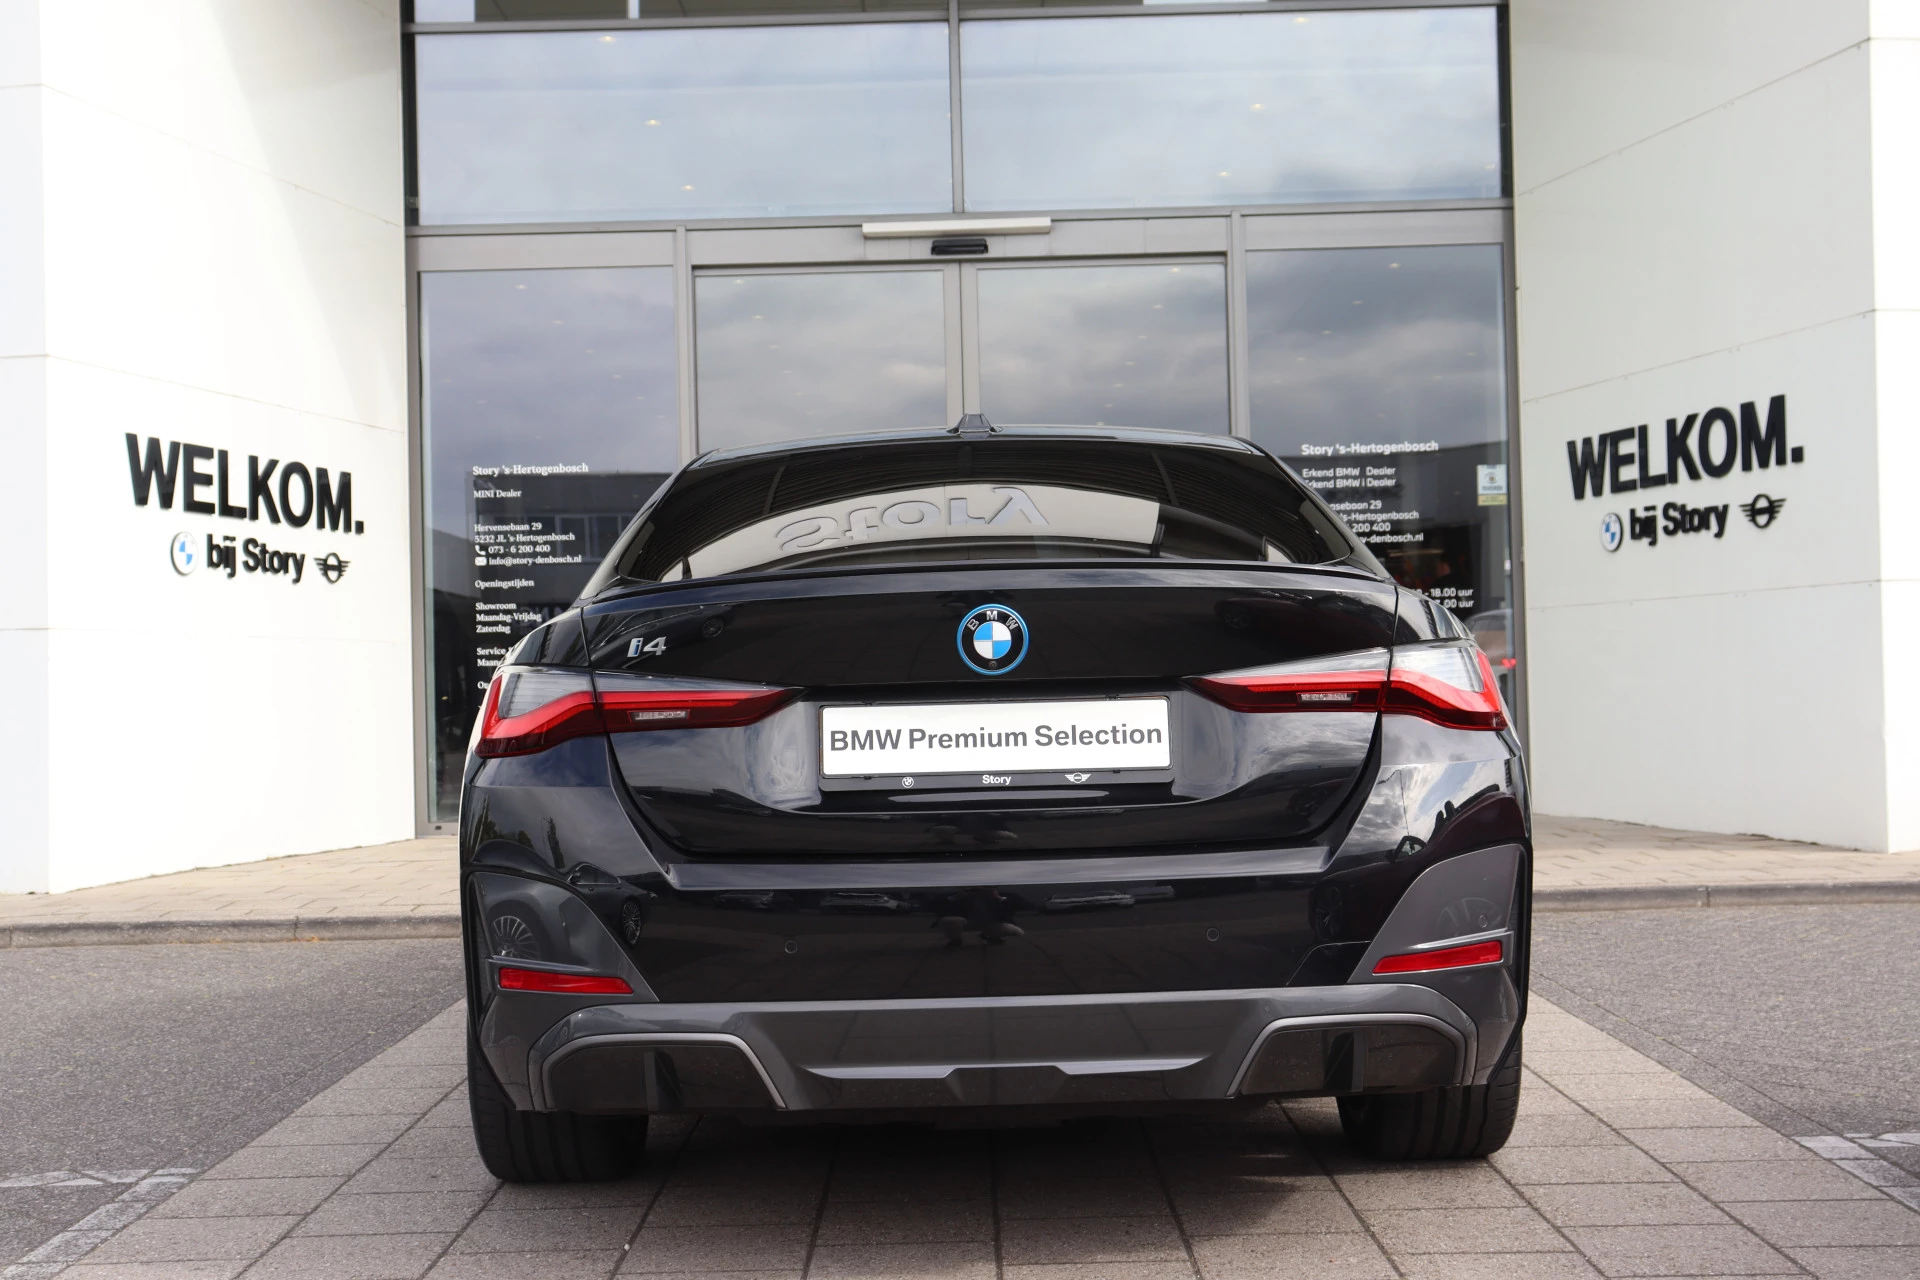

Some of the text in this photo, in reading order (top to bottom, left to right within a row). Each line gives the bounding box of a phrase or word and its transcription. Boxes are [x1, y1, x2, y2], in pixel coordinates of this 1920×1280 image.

[1301, 440, 1439, 456] Story 's-Hertogenbosch
[1567, 394, 1804, 500] WELKOM.
[472, 463, 589, 477] Story 's-Hertogenbosch
[1302, 466, 1396, 477] Erkend BMW Dealer
[125, 432, 364, 535] WELKOM.
[1336, 478, 1361, 487] BMW
[1366, 478, 1396, 487] Dealer
[473, 489, 522, 498] MINI Dealer
[1370, 500, 1382, 509] 29
[474, 523, 542, 532] Hervensebaan 29
[1352, 523, 1371, 533] 200
[1372, 522, 1391, 532] 400
[1630, 502, 1729, 547] bij Story
[474, 534, 495, 543] 5232
[507, 532, 575, 543] 's-Hertogenbosch
[488, 546, 504, 554] 073
[510, 546, 516, 554] 6
[518, 545, 533, 554] 200
[534, 545, 550, 553] 400
[207, 533, 305, 584] bij Story
[489, 555, 582, 566] info@story-denbosch.nl
[475, 579, 534, 589] Openingstijden
[1430, 588, 1456, 598] 18.00
[1457, 589, 1474, 597] uur
[475, 602, 517, 611] Showroom
[1458, 599, 1474, 608] uur
[476, 612, 542, 622] Maandag-Vrijdag
[476, 624, 511, 634] Zaterdag
[476, 647, 507, 656] Service
[627, 636, 667, 658] i4
[830, 724, 1162, 751] BMW Premium Selection
[982, 774, 1012, 786] Story
